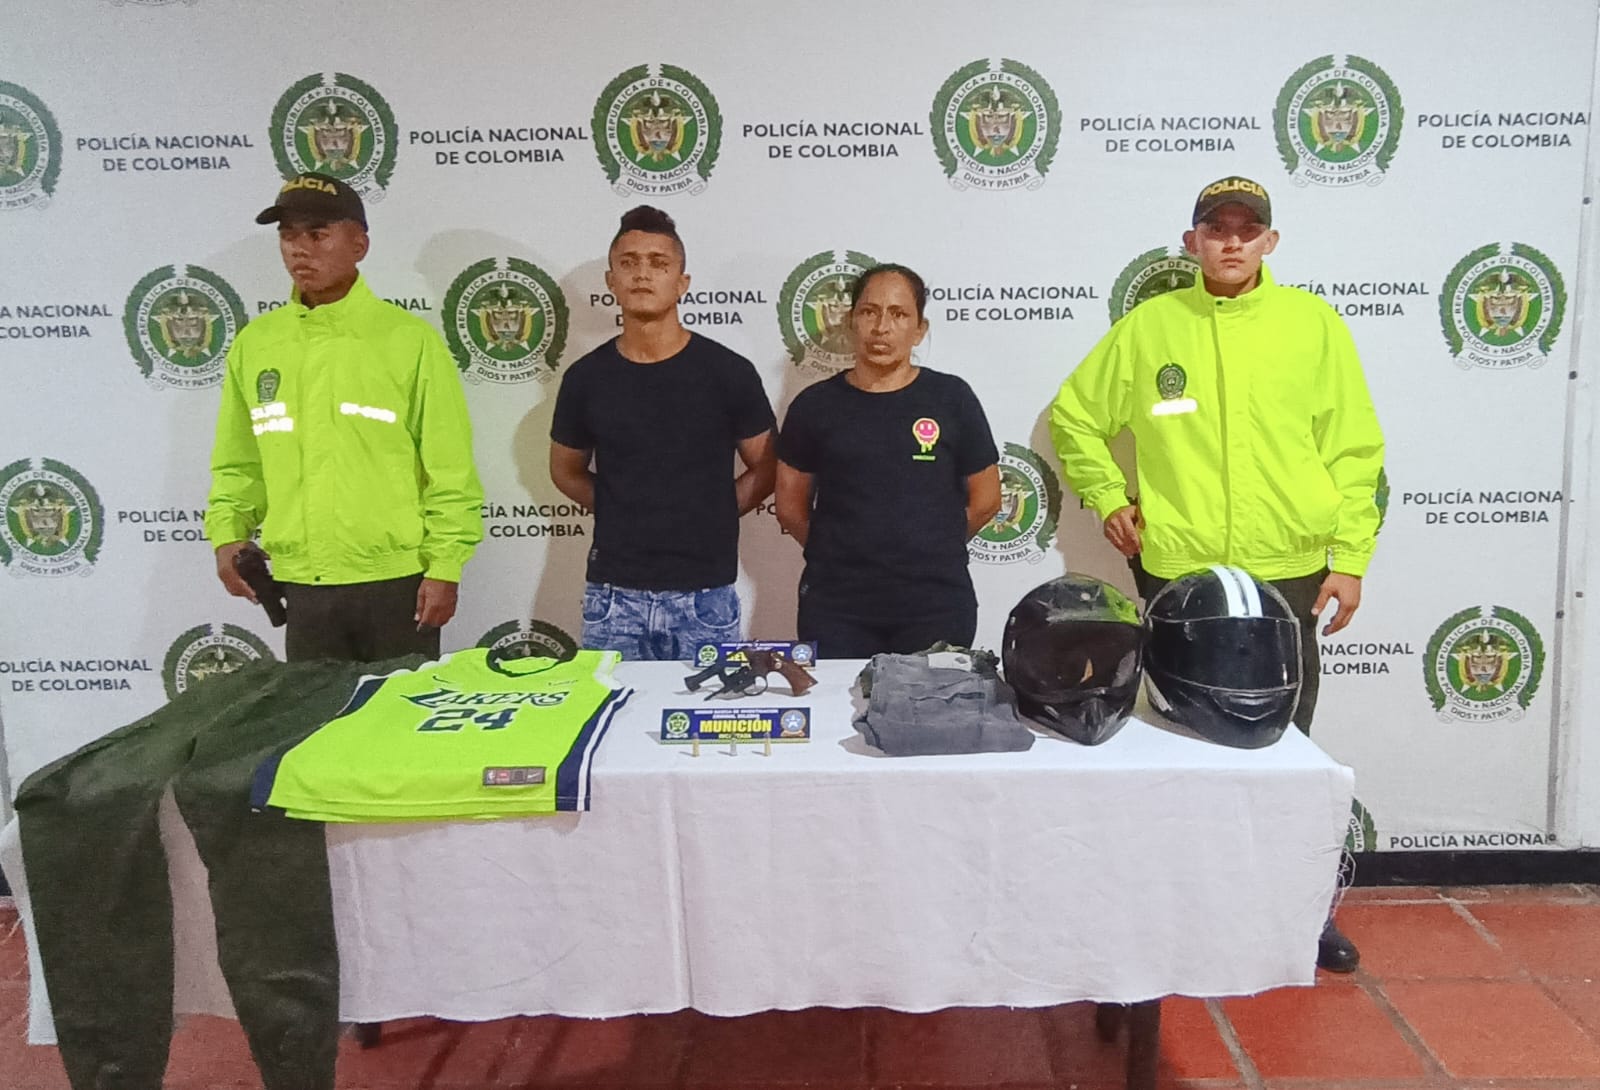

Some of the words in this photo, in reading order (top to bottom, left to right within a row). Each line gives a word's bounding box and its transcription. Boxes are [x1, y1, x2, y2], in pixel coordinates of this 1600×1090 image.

[947, 79, 979, 133] REPUBLICA
[1015, 79, 1045, 131] COLOMBIA
[1289, 76, 1323, 128] REPUBLICA
[1359, 75, 1387, 128] COLOMBIA
[609, 85, 639, 138] REPUBLICA
[674, 84, 706, 136] COLOMBIA
[1418, 111, 1492, 127] POLICÍA
[743, 120, 817, 137] POLICÍA
[824, 123, 922, 136] NACIONAL
[1081, 115, 1154, 131] POLICÍA
[1162, 117, 1260, 130] NACIONAL
[77, 133, 150, 150] POLICÍA
[156, 135, 253, 149] NACIONAL
[410, 126, 483, 144] POLICÍA
[489, 127, 588, 142] NACIONAL
[1443, 136, 1465, 148] DE
[1472, 134, 1571, 148] COLOMBIA
[769, 145, 792, 158] DE
[799, 144, 898, 158] COLOMBIA
[1106, 139, 1129, 152] DE
[1136, 138, 1235, 151] COLOMBIA
[103, 158, 126, 171] DE
[133, 156, 230, 170] COLOMBIA
[436, 152, 459, 164] DE
[465, 149, 564, 164] COLOMBIA
[615, 149, 647, 179] POLICIA
[660, 148, 703, 180] NACIONAL
[953, 145, 984, 173] POLICIA
[998, 144, 1040, 174] NACIONAL
[1296, 141, 1326, 169] POLICIA
[1338, 141, 1382, 171] NACIONAL
[1001, 287, 1098, 300] NACIONAL
[1126, 266, 1158, 305] PUBLICA
[1333, 283, 1429, 296] NACIONAL
[1455, 262, 1489, 314] REPUBLICA
[1523, 263, 1550, 313] COLOMBIA
[17, 304, 112, 318] NACIONAL
[459, 277, 487, 329] REPUBLICA
[521, 277, 553, 327] COLOMBIA
[1338, 303, 1404, 316] LOMBIA
[684, 312, 742, 325] OMBIA
[947, 309, 969, 321] DE
[976, 307, 1073, 320] COLOMBIA
[1459, 326, 1489, 353] POLICIA
[1501, 325, 1544, 354] NACIONAL
[466, 341, 498, 367] POLICIA
[509, 340, 550, 369] NACIONAL
[1017, 462, 1047, 510] COLOMBIA
[1403, 489, 1473, 504] POLICÍA
[1480, 491, 1563, 504] NACIONA
[118, 508, 188, 523] POLICÍA
[513, 503, 595, 518] NACIONA
[1426, 512, 1448, 524] DE
[1454, 511, 1548, 523] COLOMBIA
[144, 530, 166, 542] DE
[490, 524, 585, 537] COLOMBIA
[1000, 522, 1041, 550] NACIONAL
[1321, 643, 1413, 656] NACIONAL
[1438, 624, 1470, 671] REPUBLICA
[1504, 624, 1530, 670] COLOMBIA
[0, 659, 55, 673] OLICÍA
[61, 659, 152, 672] NACIONAL
[1323, 662, 1389, 674] LOMBIA
[12, 680, 34, 691] DE
[40, 679, 131, 691] COLOMBIA
[401, 688, 569, 708] LAKERS
[1442, 683, 1471, 707] POLICIA
[1482, 683, 1523, 708] NACIONAL
[417, 708, 519, 732] 24
[700, 719, 772, 733] MUNICIÓN
[1349, 818, 1362, 850] OMBIA
